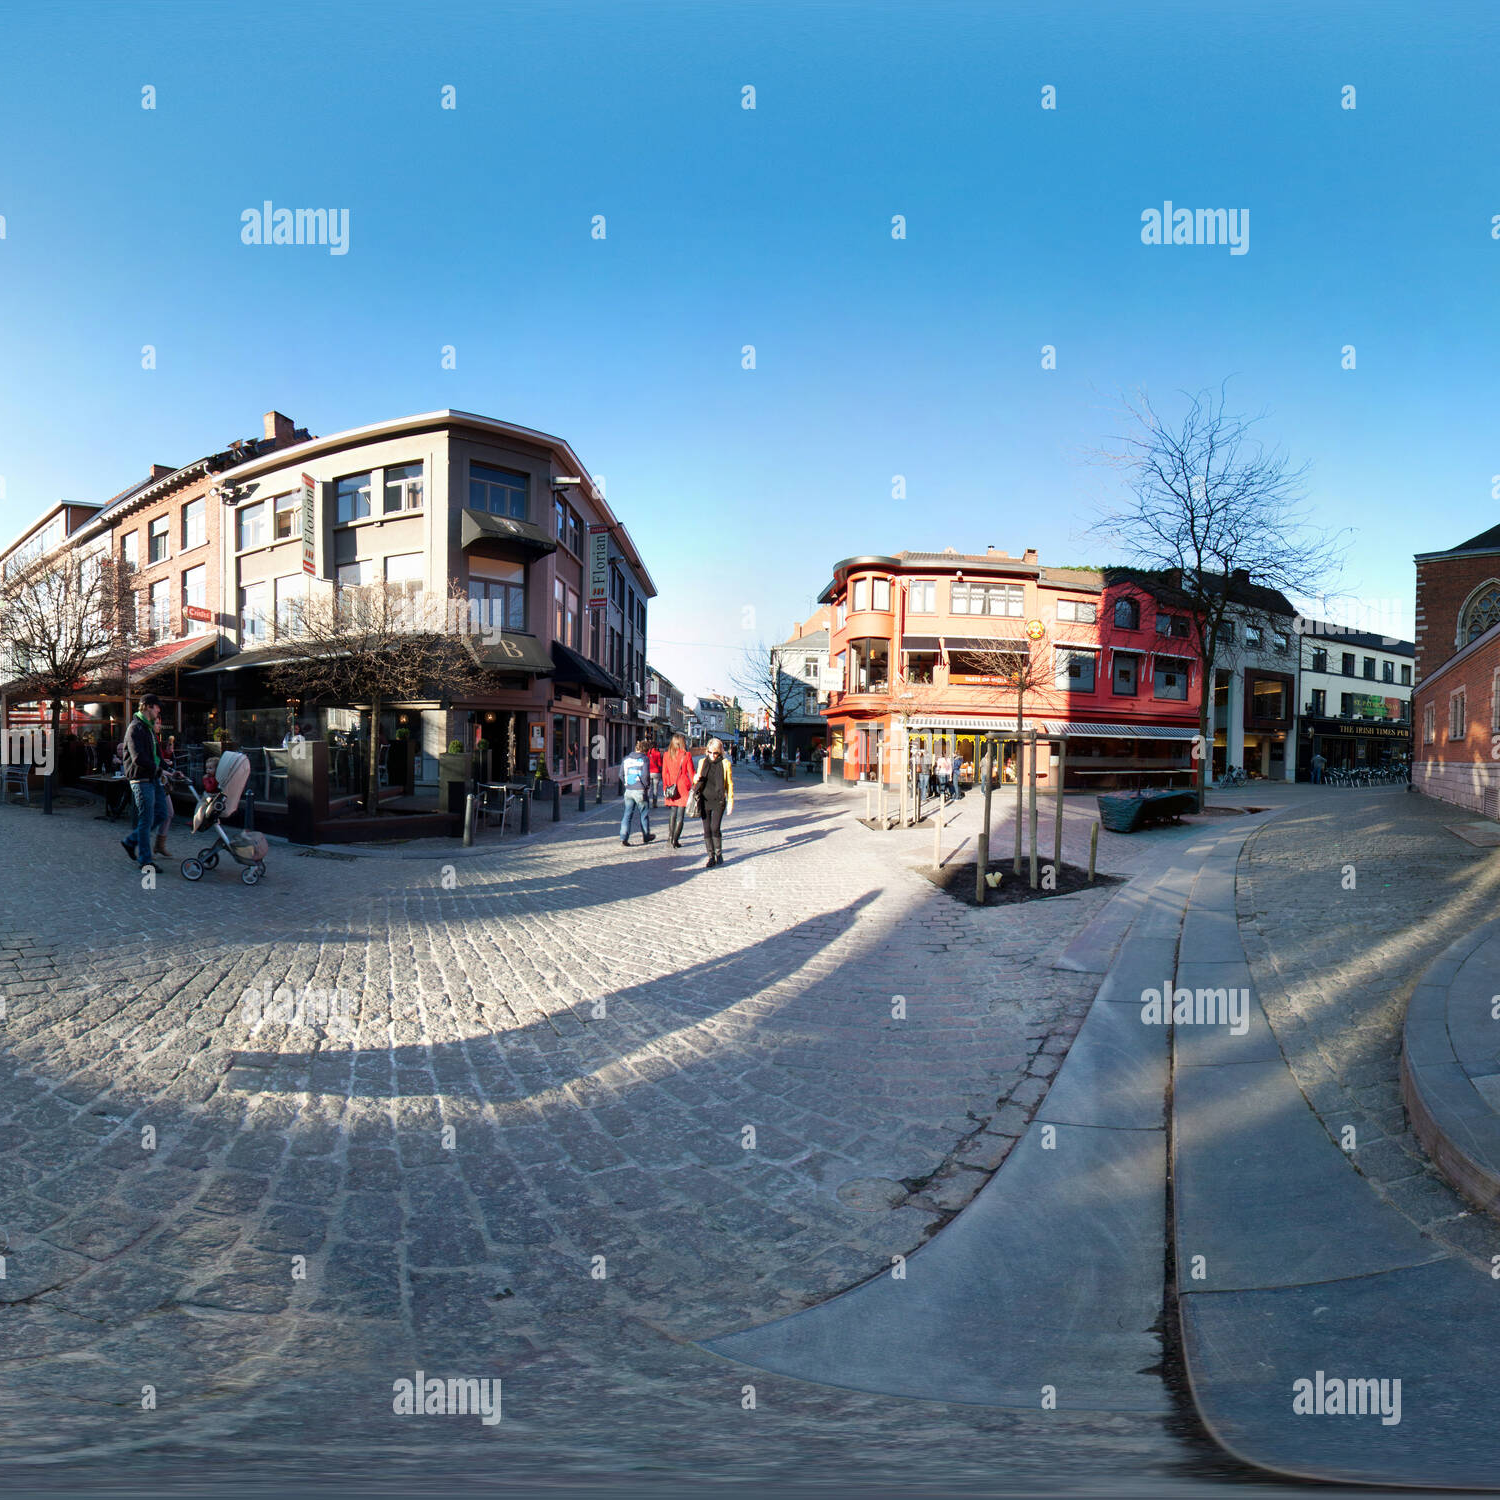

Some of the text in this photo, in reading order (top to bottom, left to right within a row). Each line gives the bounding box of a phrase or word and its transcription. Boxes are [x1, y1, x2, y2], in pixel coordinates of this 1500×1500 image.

[304, 489, 315, 547] Florian
[592, 535, 605, 584] Florian
[500, 639, 524, 658] B
[1356, 727, 1374, 735] IRISH
[1376, 728, 1396, 736] TIMES
